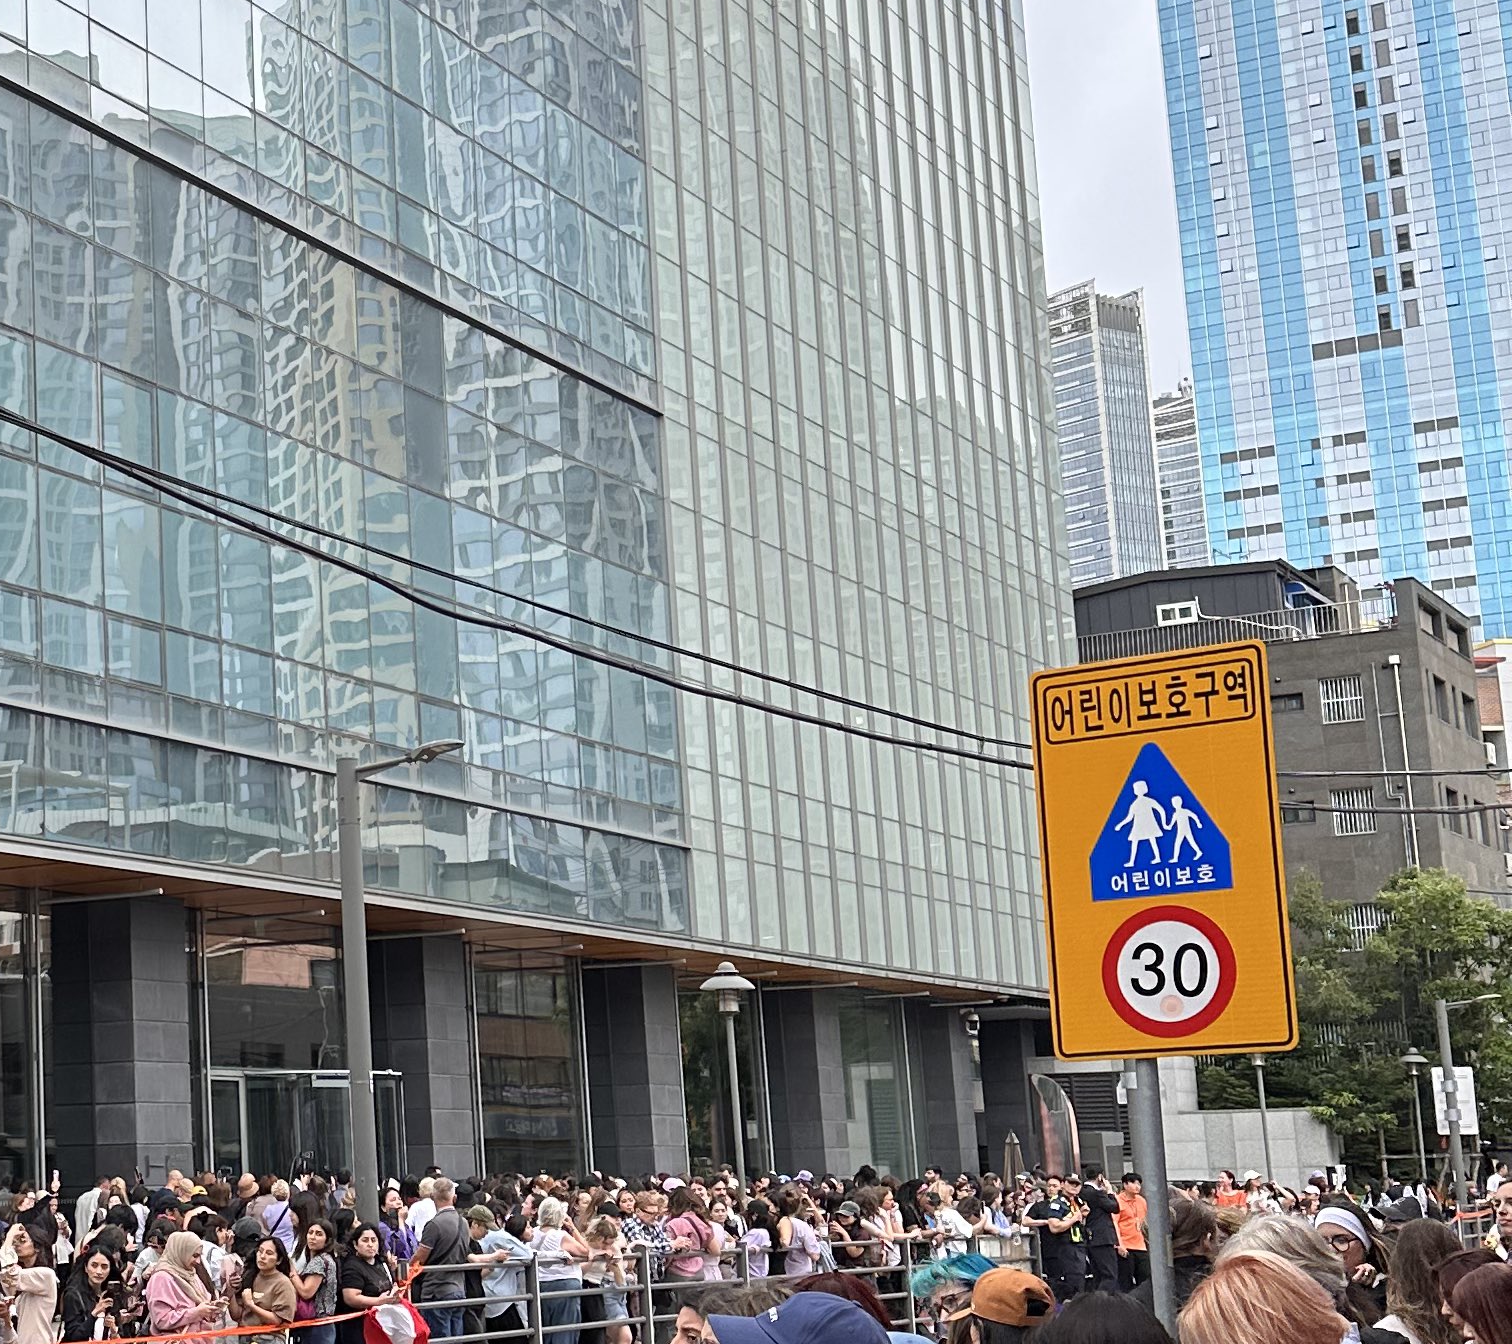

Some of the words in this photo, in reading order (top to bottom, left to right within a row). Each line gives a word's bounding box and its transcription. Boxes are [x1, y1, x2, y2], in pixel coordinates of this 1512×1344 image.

[1051, 665, 1249, 736] 어린이보호구역
[1111, 863, 1216, 893] 어린이보호
[1130, 942, 1208, 997] 30
